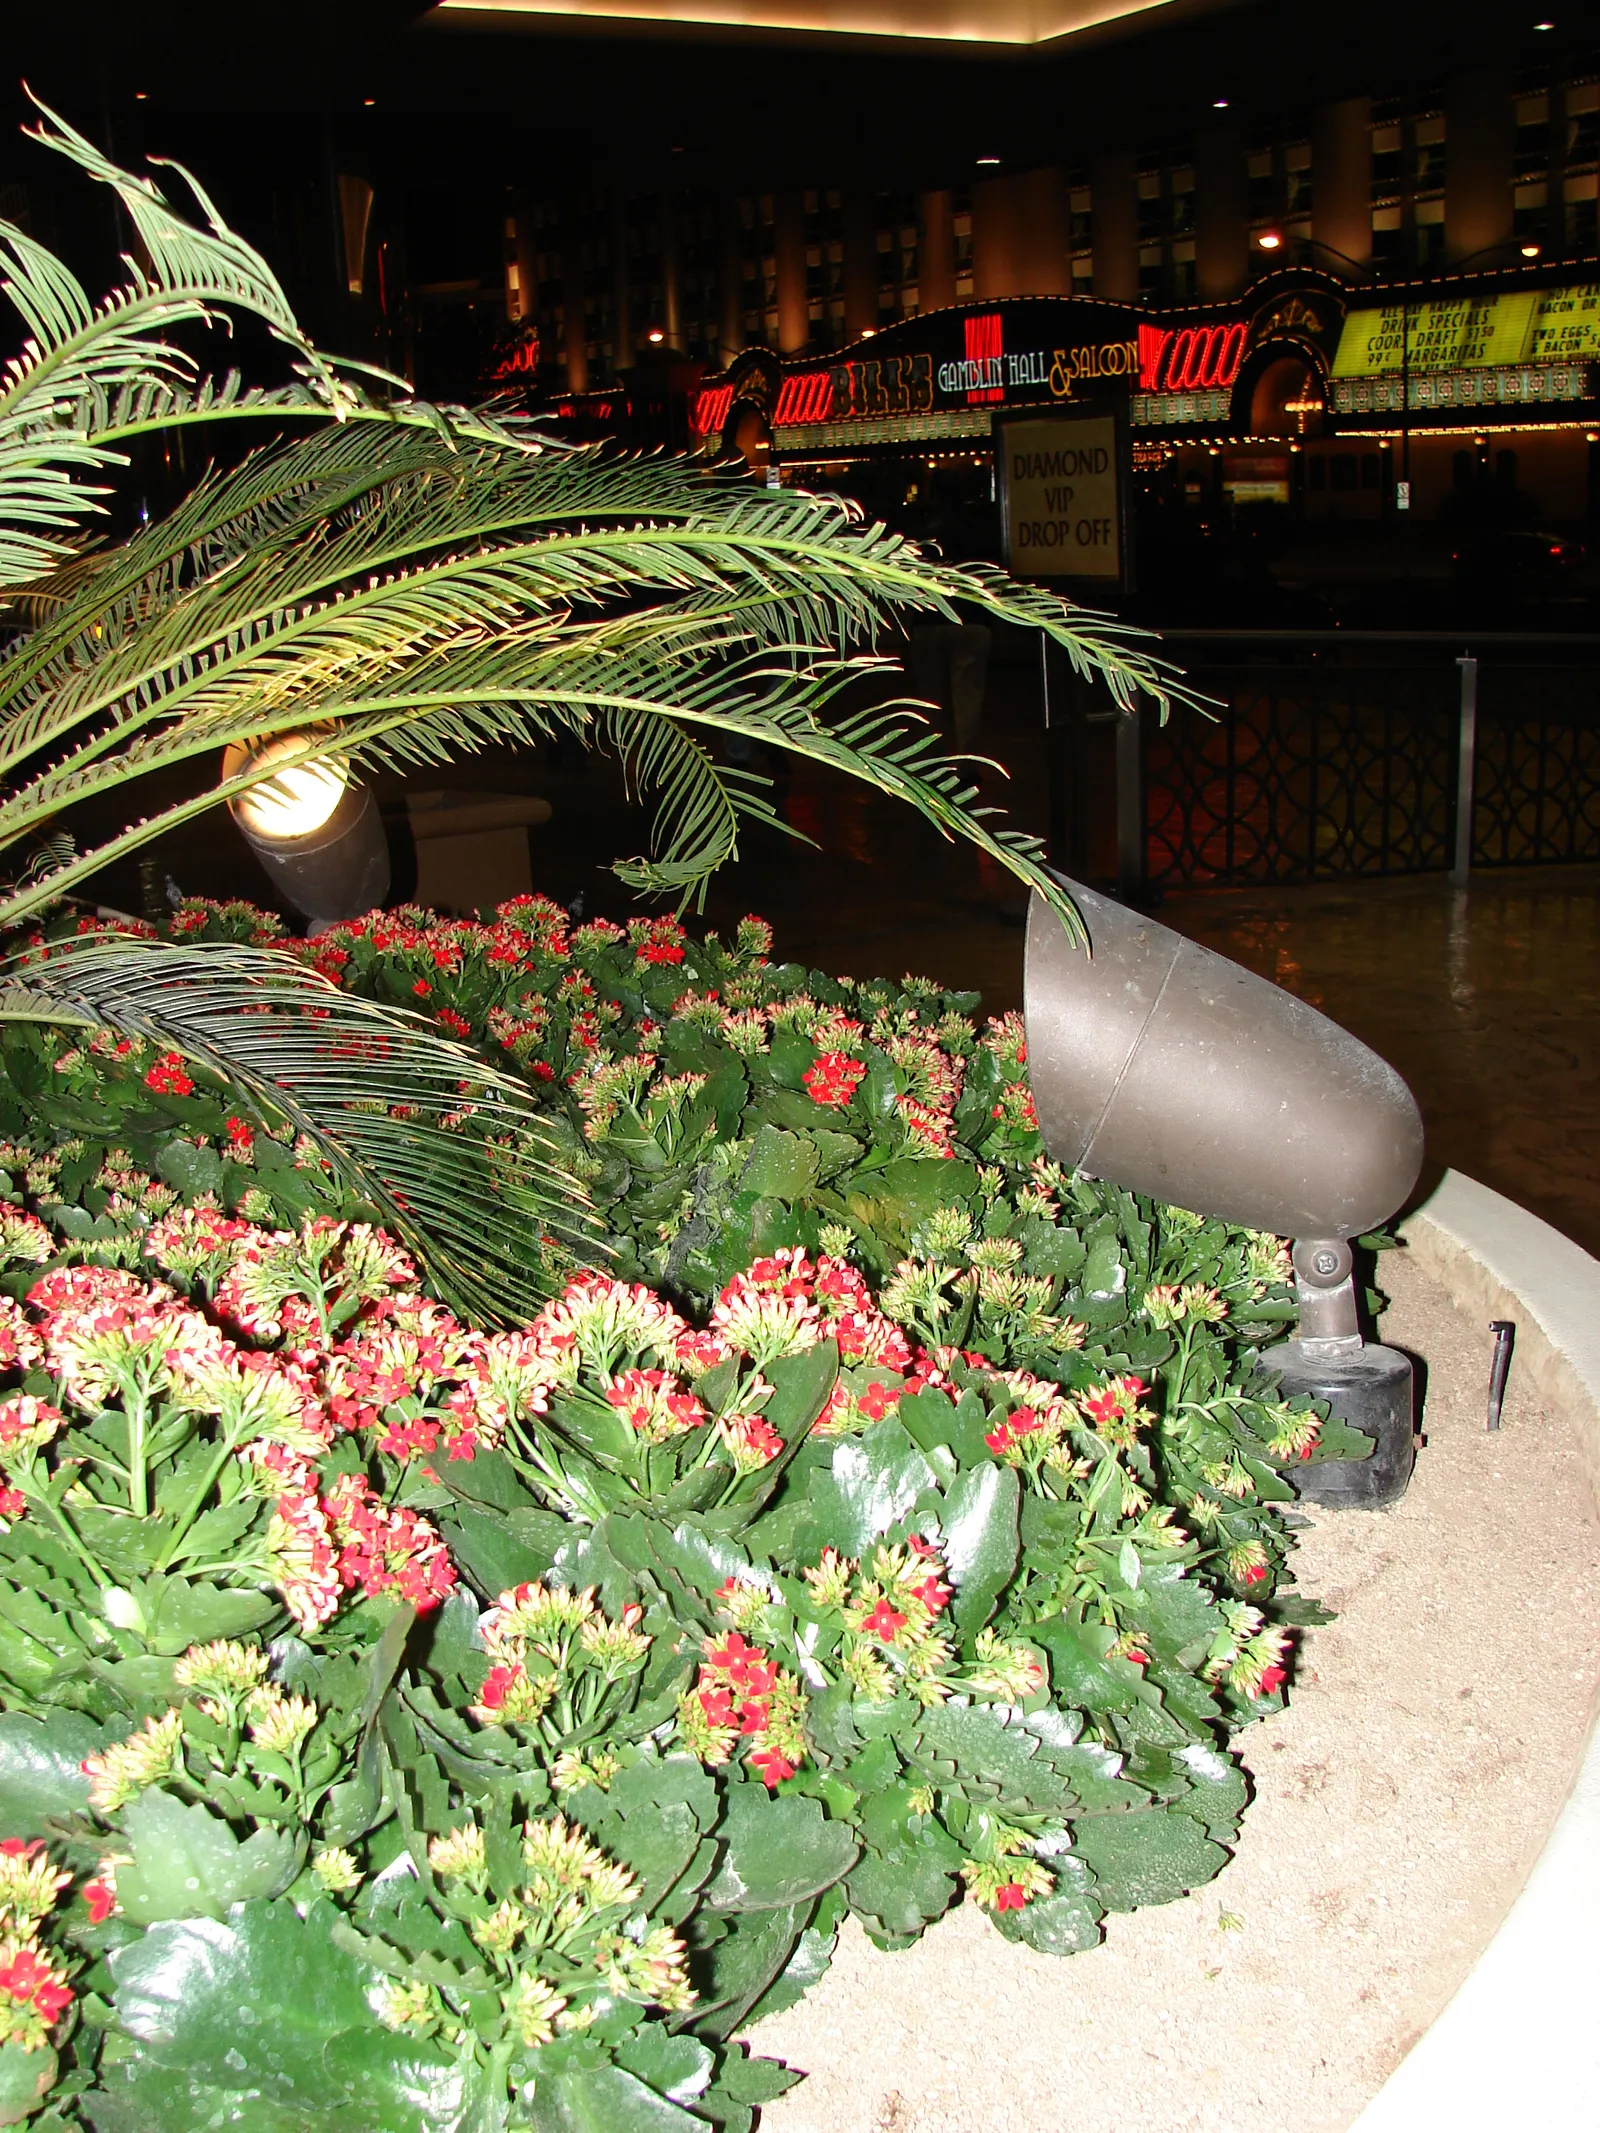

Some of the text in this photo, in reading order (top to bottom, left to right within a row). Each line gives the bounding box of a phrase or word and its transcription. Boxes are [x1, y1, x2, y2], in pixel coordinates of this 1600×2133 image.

[1428, 309, 1490, 330] SPECIALS
[1415, 329, 1458, 348] DRAFT
[1560, 325, 1592, 339] EGGS
[1544, 339, 1583, 353] BACON
[829, 353, 934, 418] BILL'S
[1008, 352, 1049, 386] HALL
[1050, 350, 1072, 396] &
[1070, 341, 1139, 379] SALOON
[1013, 447, 1109, 480] DIAMOND
[1044, 486, 1074, 513] VIP
[1018, 517, 1111, 548] DROP OFF
